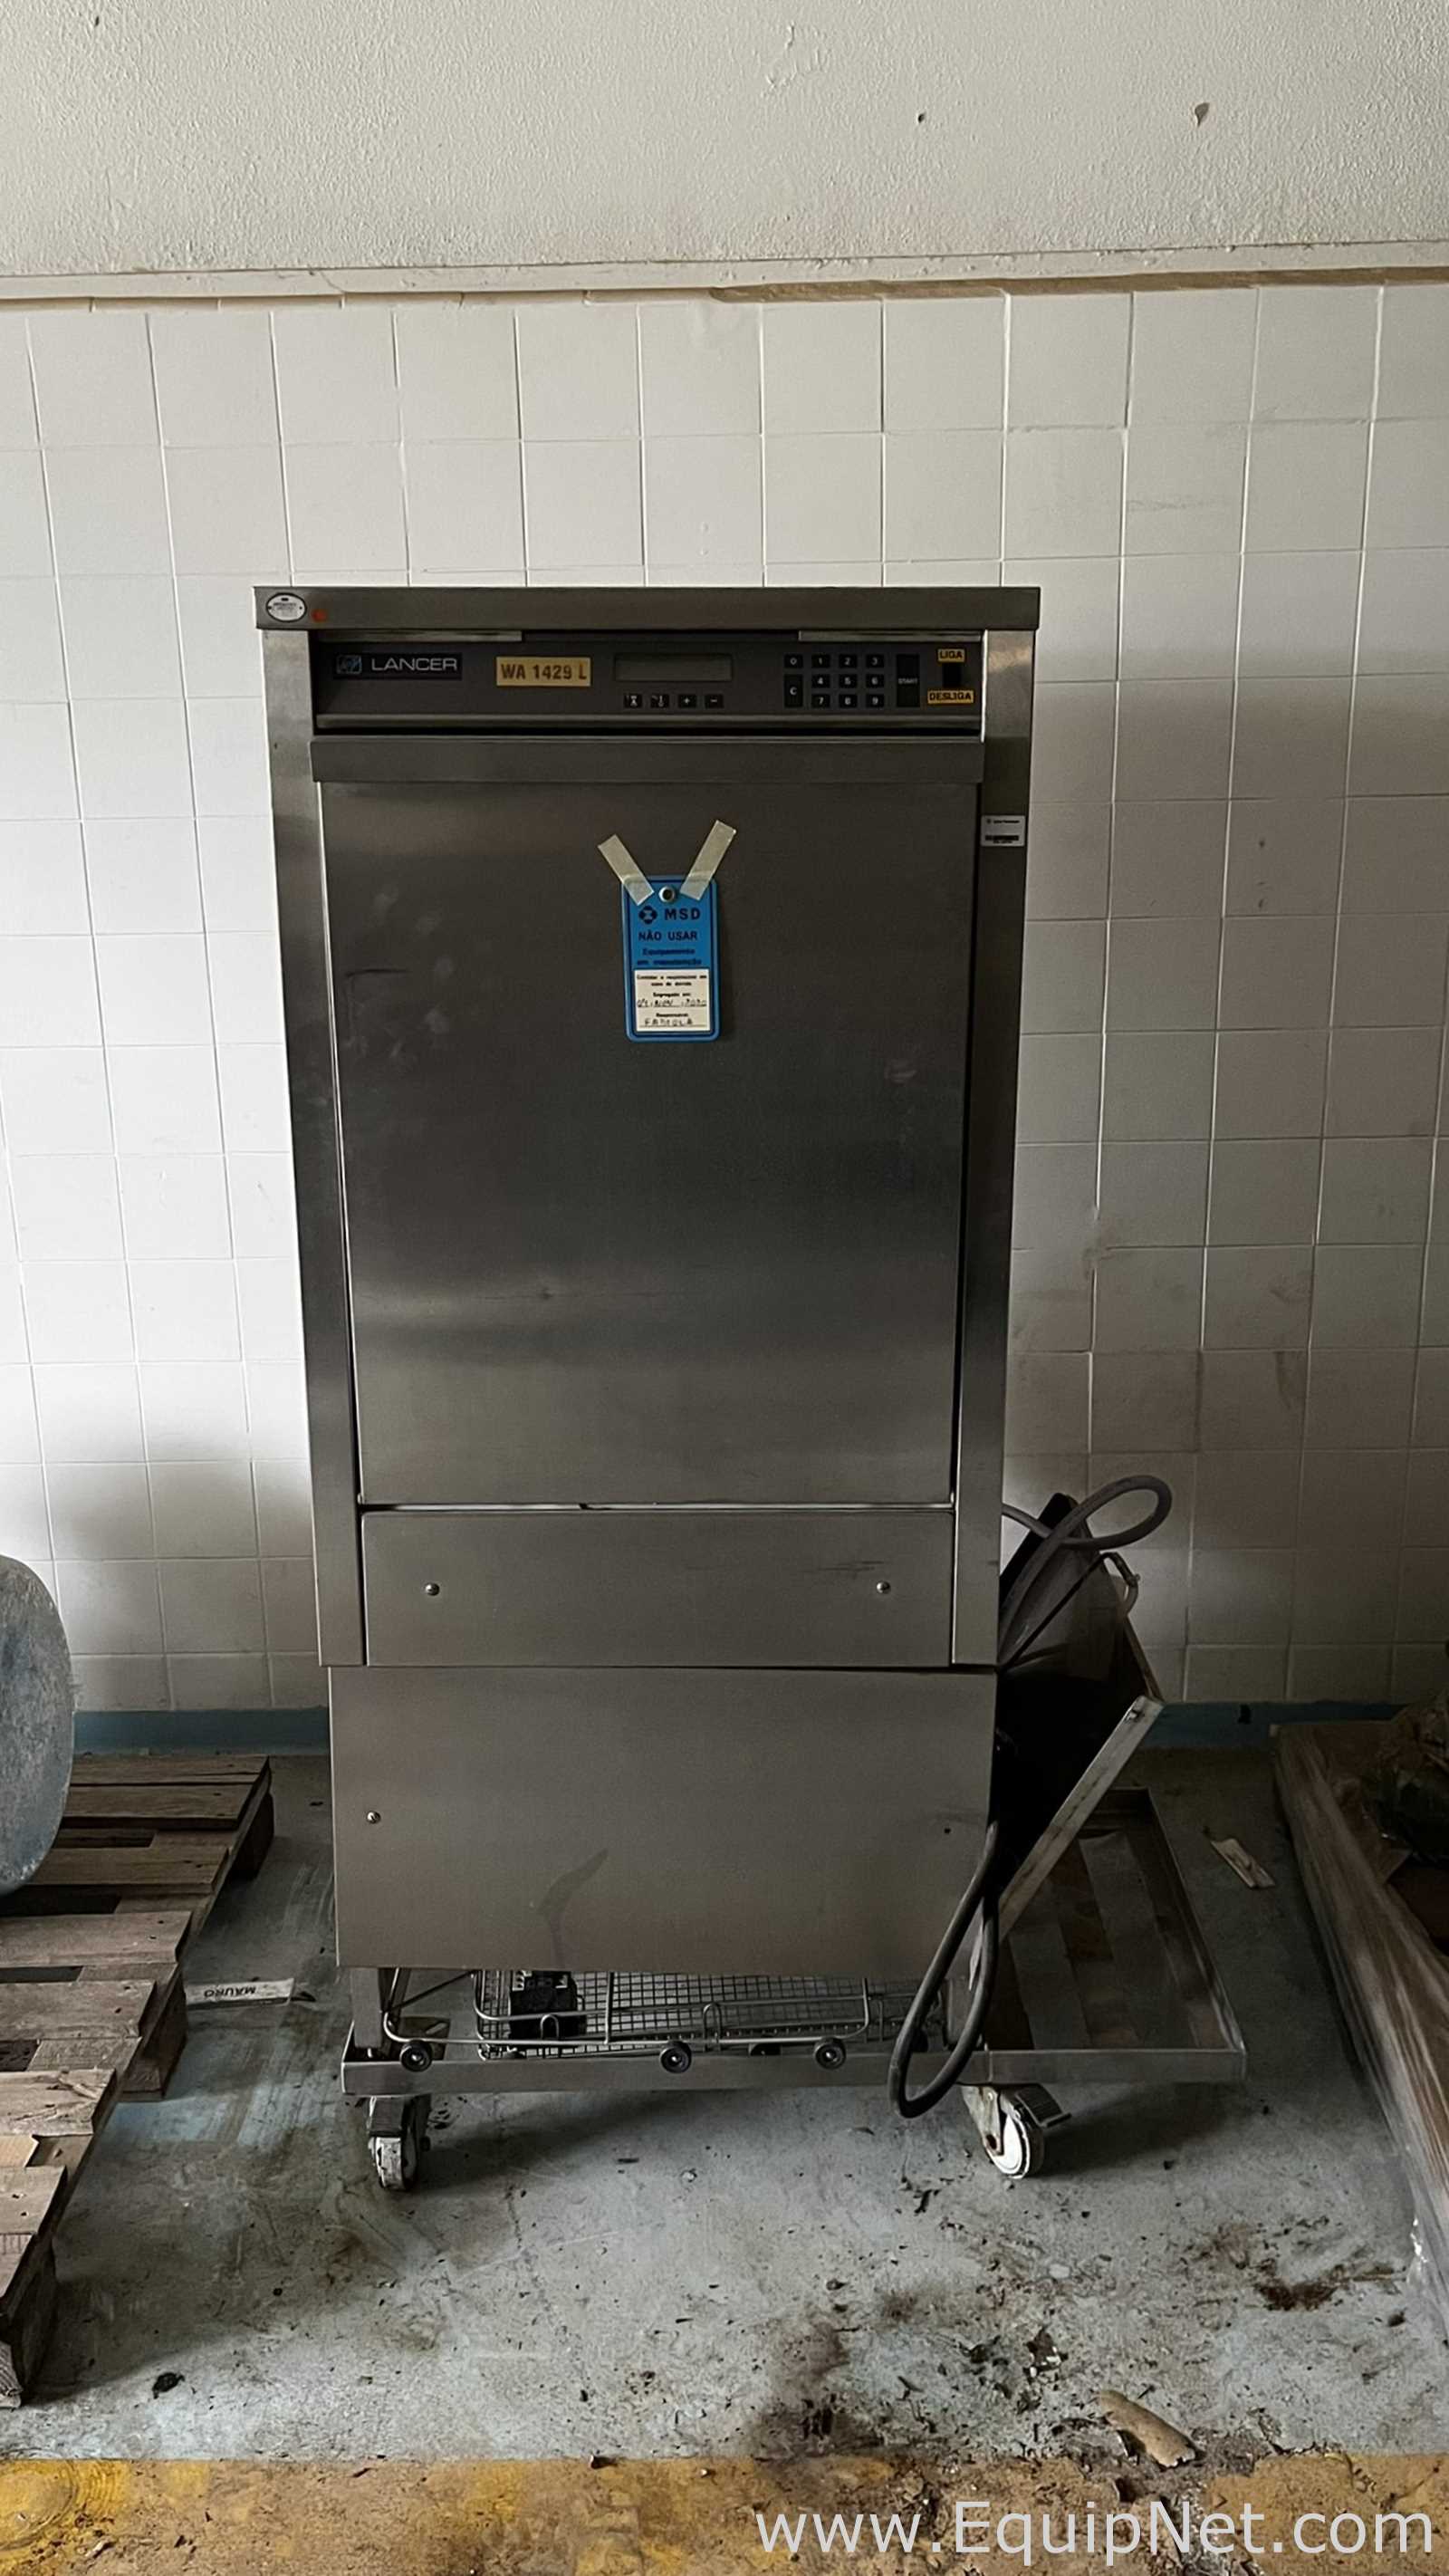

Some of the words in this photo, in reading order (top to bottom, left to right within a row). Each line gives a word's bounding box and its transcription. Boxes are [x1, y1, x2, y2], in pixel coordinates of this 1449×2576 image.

[939, 649, 963, 659] LIGA
[371, 658, 457, 672] LANCER
[844, 657, 851, 666] 2
[871, 657, 878, 666] 3
[501, 663, 526, 679] WA
[532, 663, 572, 680] 1429
[578, 663, 587, 680] L
[817, 677, 824, 686] 4
[844, 677, 851, 686] 5
[871, 677, 878, 686] 6
[897, 677, 918, 686] START
[789, 686, 797, 696] C
[818, 697, 824, 706] 7
[844, 697, 851, 706] 8
[871, 697, 878, 706] 9
[928, 691, 972, 702] DESLIGA
[664, 908, 701, 921] MSD
[638, 928, 662, 941] NÃO
[667, 930, 698, 941] USAR
